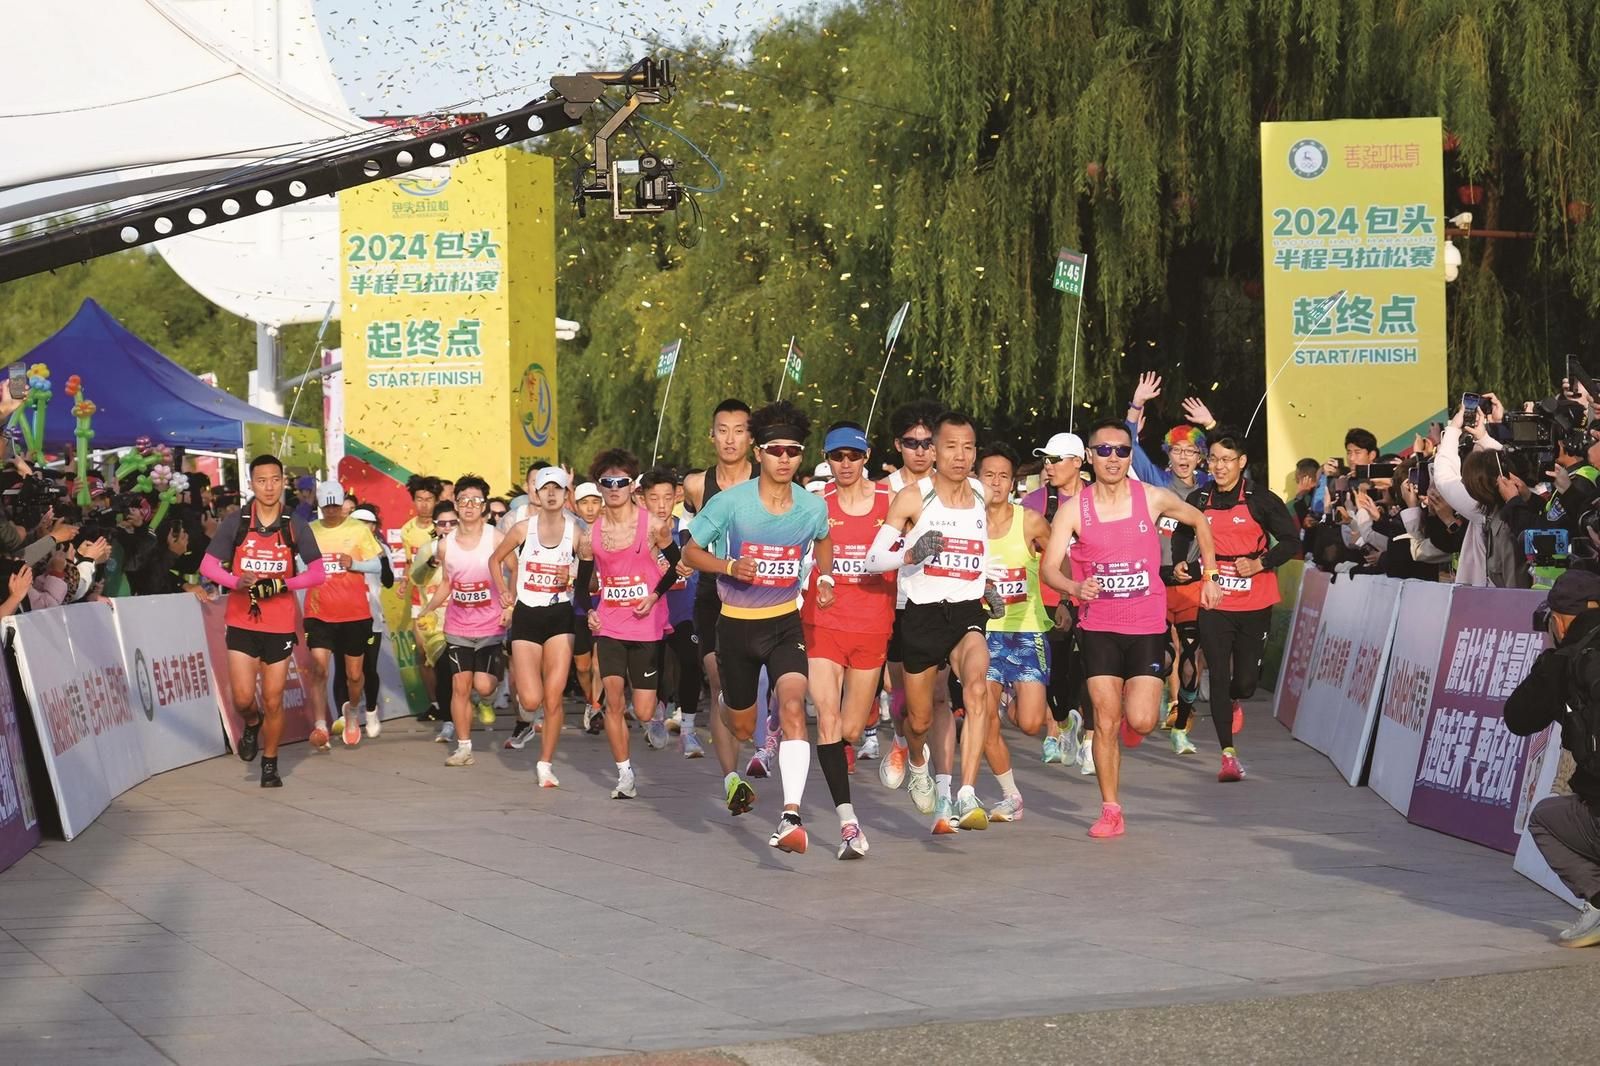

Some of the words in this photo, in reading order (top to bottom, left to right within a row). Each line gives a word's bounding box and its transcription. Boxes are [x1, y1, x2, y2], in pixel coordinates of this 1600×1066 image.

[1273, 207, 1359, 236] 2024
[1364, 205, 1436, 234] 包头
[348, 233, 428, 262] 2024
[434, 231, 500, 259] 包头
[1274, 246, 1436, 270] 半程马拉松赛
[1058, 261, 1080, 281] 1:45
[349, 271, 499, 295] 半程马拉松赛
[1055, 279, 1078, 293] PACER
[1293, 295, 1416, 336] 起终点
[366, 319, 482, 358] 起终点
[1295, 347, 1417, 364] START/FINISH
[368, 371, 482, 387] START/FINISH
[245, 560, 283, 571] A0178
[757, 560, 795, 575] 0253
[931, 553, 980, 569] A1310
[999, 582, 1023, 594] 122
[1218, 576, 1247, 589] 0172
[455, 591, 487, 601] A0785
[607, 586, 644, 599] A0260
[152, 651, 210, 706] 包头市体育局
[1415, 706, 1478, 788] 跑起来
